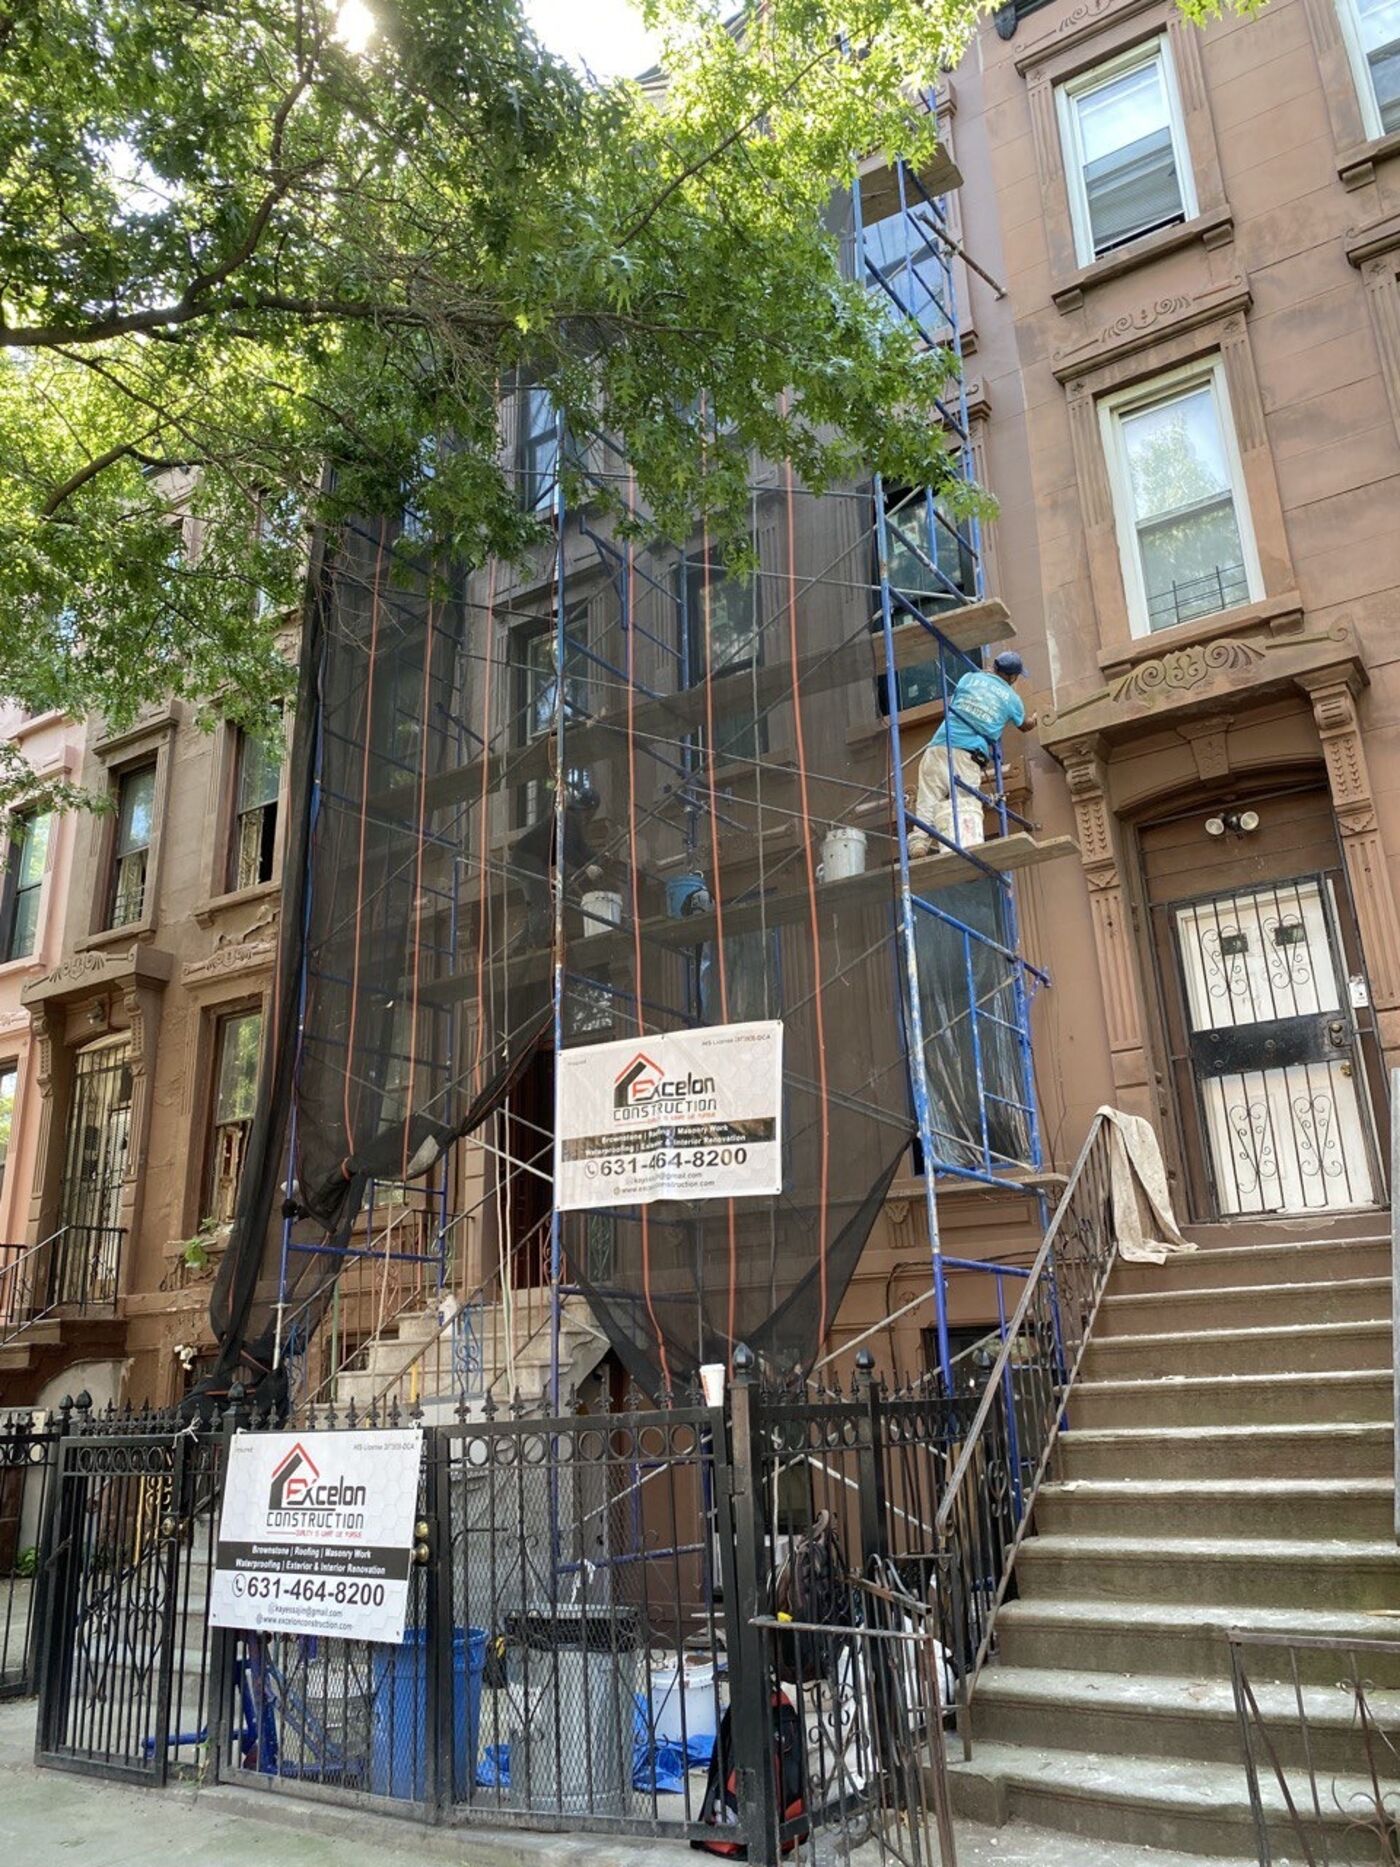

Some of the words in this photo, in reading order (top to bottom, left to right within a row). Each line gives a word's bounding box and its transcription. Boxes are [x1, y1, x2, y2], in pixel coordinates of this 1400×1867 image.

[632, 1072, 715, 1101] Excelon
[613, 1098, 716, 1120] CONSTRUCTION
[601, 1131, 644, 1144] Brownstone
[677, 1124, 710, 1137] Masonry
[710, 1124, 728, 1134] Work
[704, 1134, 746, 1145] Renovation
[600, 1147, 748, 1177] 631-464-8200
[286, 1475, 366, 1506] Excelon
[266, 1512, 364, 1529] CONSTRUCTION
[251, 1545, 290, 1556] Brownstone
[294, 1546, 320, 1558] Roofing
[324, 1548, 353, 1560] Masonry
[354, 1548, 372, 1559] Work
[235, 1560, 281, 1571] Waterproofing
[286, 1560, 312, 1571] Exterior
[314, 1562, 320, 1571] &
[320, 1563, 346, 1573] Interior
[347, 1564, 386, 1576] Renovation
[247, 1576, 385, 1606] 631-464-8200
